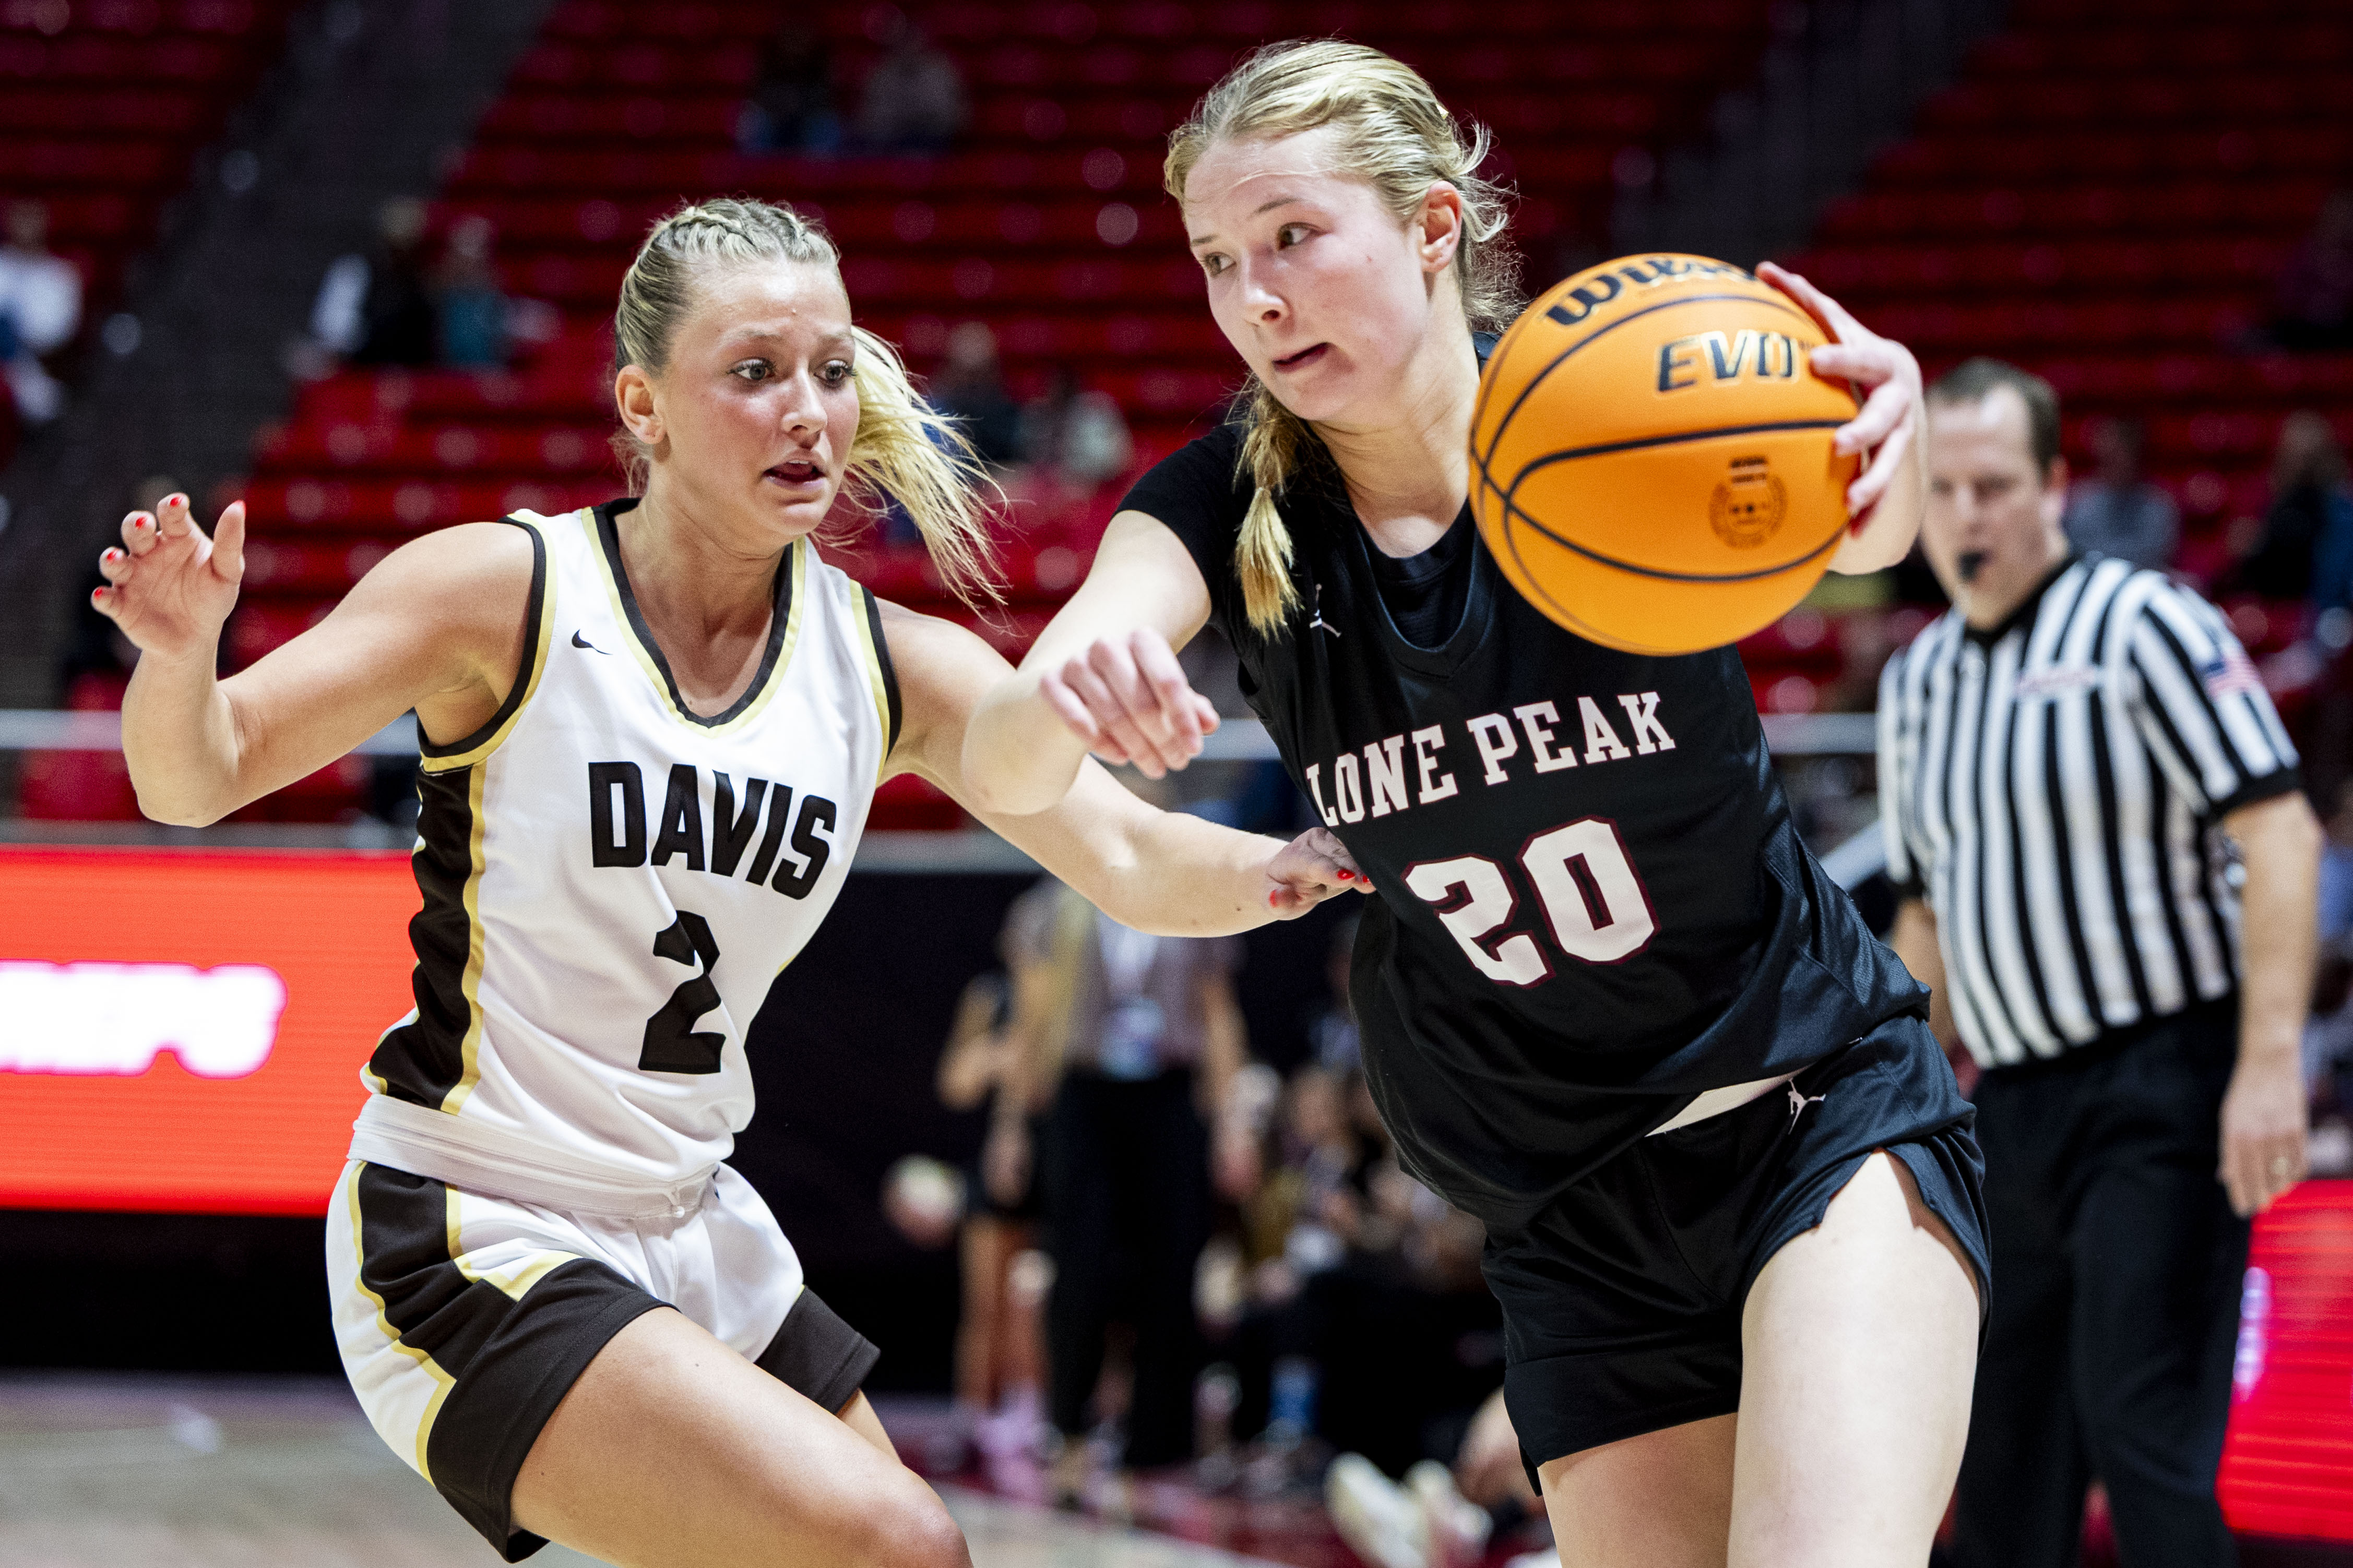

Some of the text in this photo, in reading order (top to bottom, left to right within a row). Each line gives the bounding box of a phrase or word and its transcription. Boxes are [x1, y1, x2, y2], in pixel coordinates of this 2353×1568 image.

[588, 761, 837, 900] DAVIS
[1306, 691, 1676, 827] LONE PEAK
[1402, 815, 1661, 989] 20
[638, 909, 727, 1074] 2
